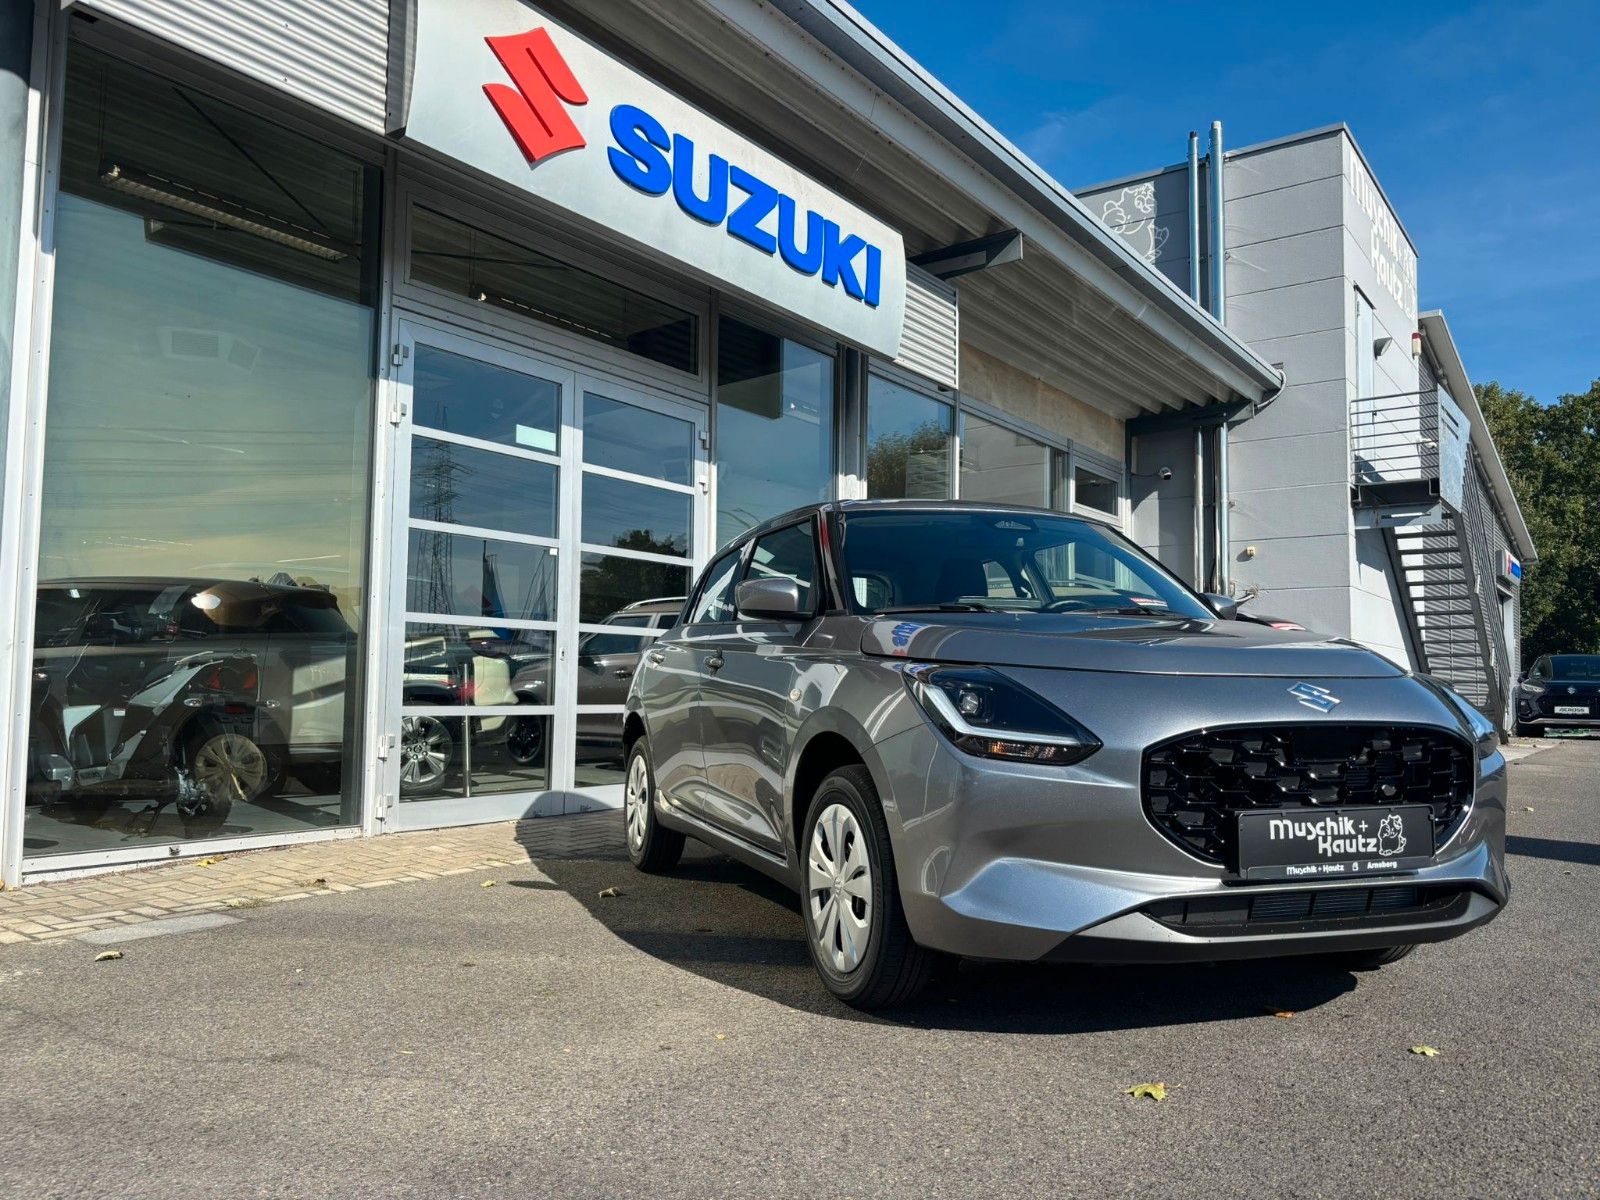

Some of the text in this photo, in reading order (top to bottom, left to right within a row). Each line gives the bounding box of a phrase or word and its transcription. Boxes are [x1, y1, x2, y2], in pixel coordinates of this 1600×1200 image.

[607, 104, 881, 309] SUZUKI
[1318, 834, 1377, 857] Hautz
[1367, 861, 1398, 869] Arnsberg
